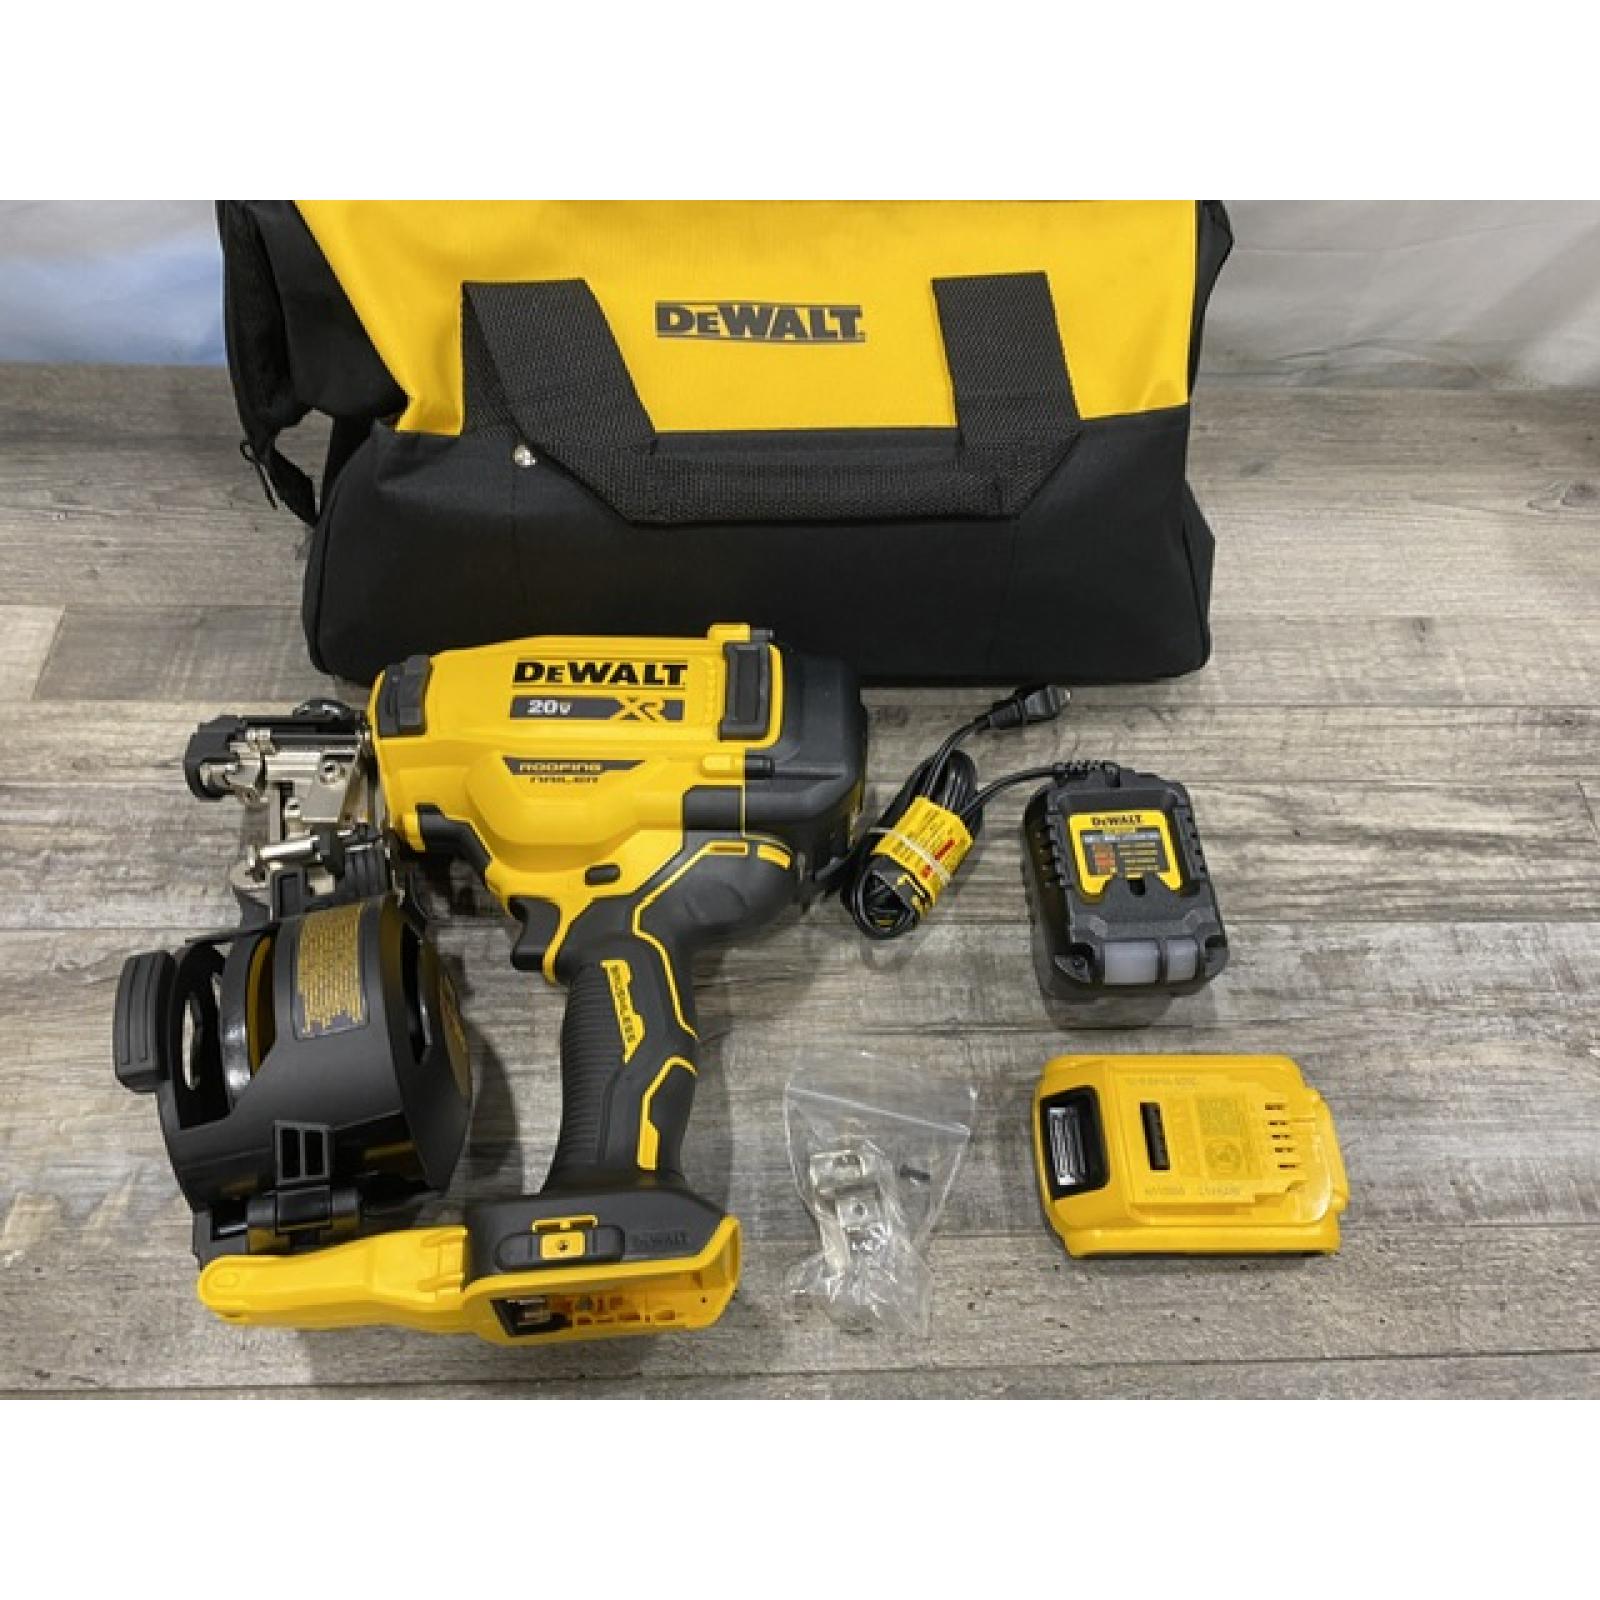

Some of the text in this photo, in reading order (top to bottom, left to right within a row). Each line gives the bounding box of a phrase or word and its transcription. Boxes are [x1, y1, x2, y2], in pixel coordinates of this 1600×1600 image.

[656, 302, 864, 342] DEWALT
[513, 660, 687, 687] DEWALT
[527, 699, 572, 715] 20V
[1090, 814, 1142, 826] DEWALT
